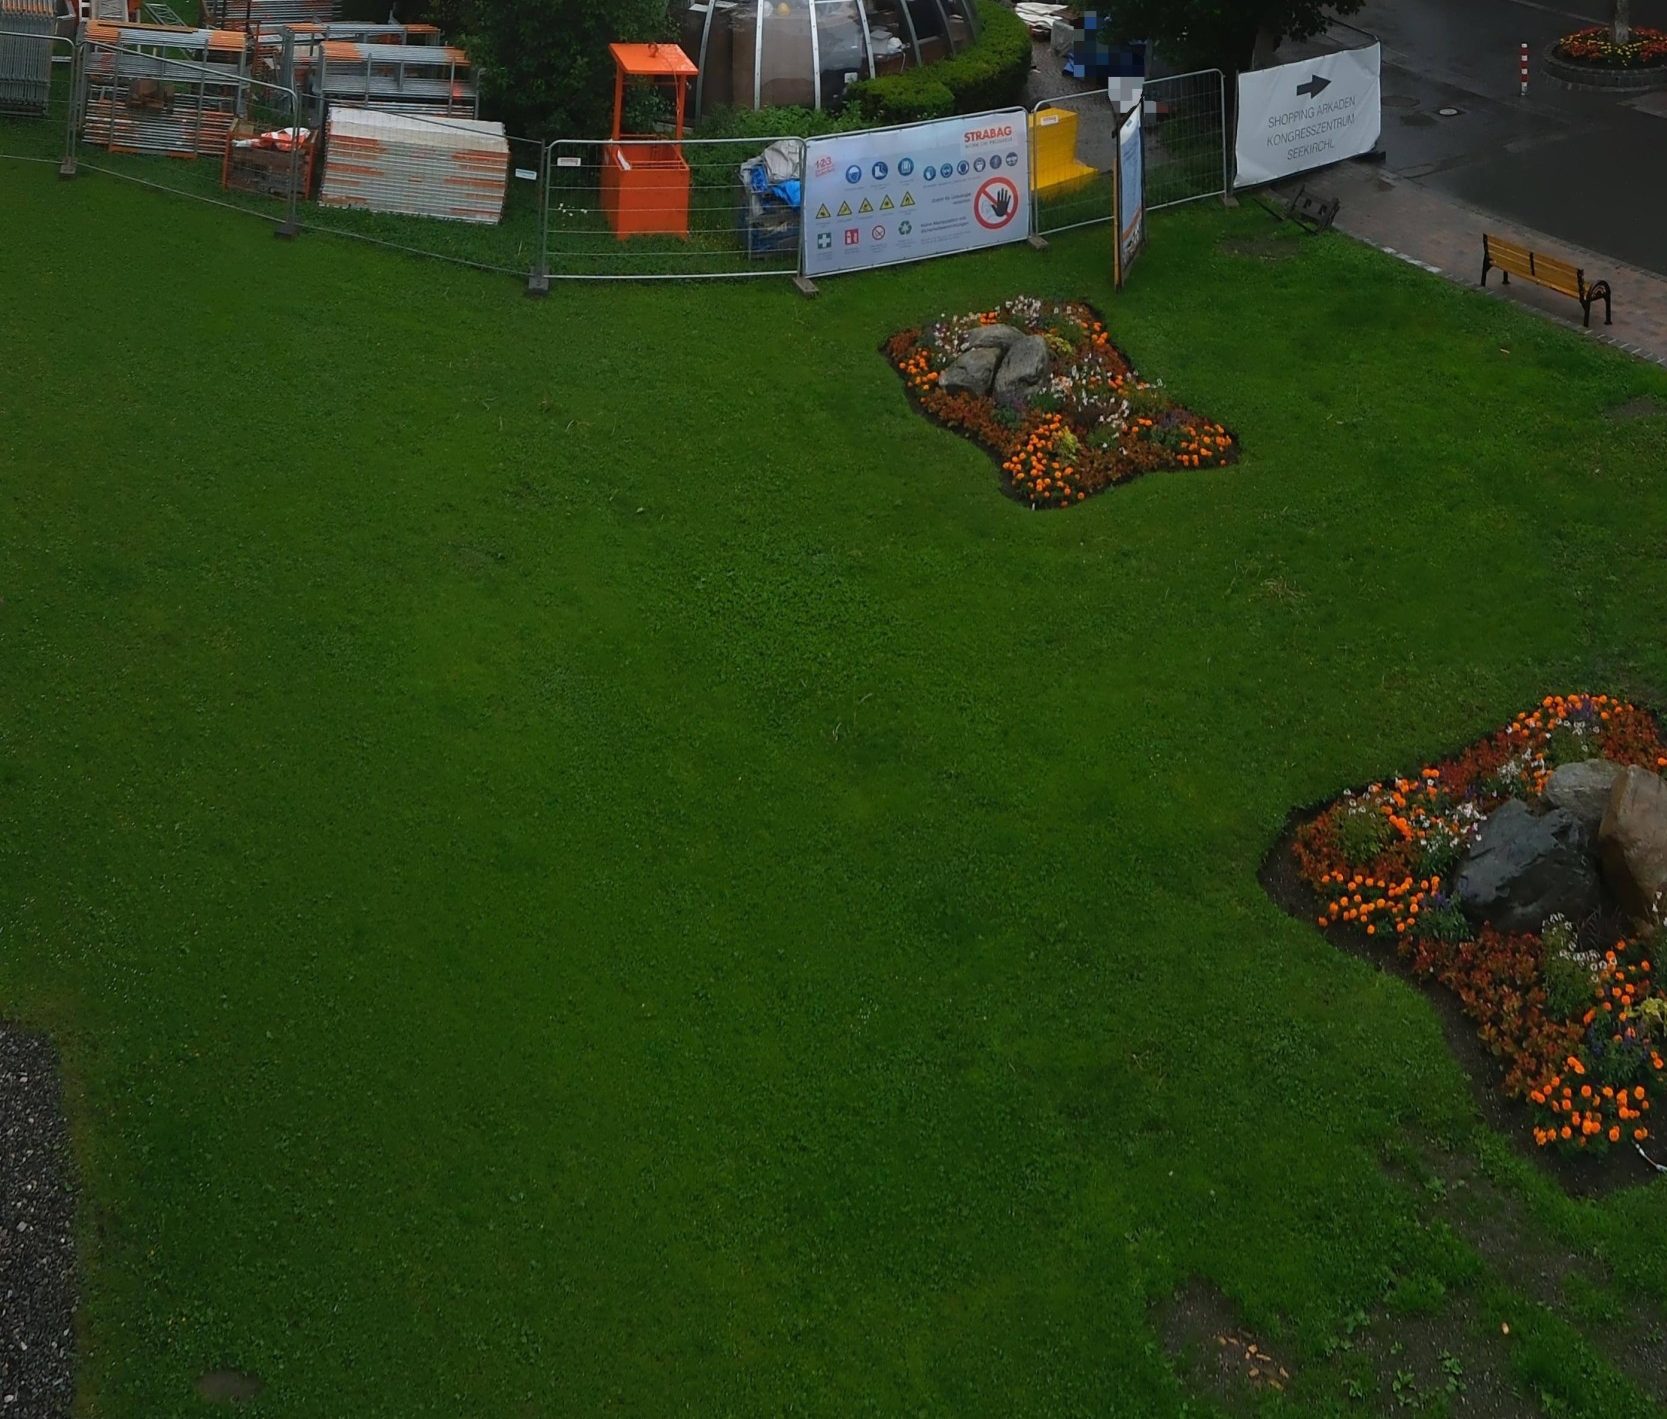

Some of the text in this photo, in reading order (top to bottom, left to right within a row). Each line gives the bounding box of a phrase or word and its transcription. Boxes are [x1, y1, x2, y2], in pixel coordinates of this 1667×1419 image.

[1268, 96, 1356, 129] SHOPPING ARKADEN
[964, 126, 1012, 143] STRABAG
[1266, 113, 1355, 147] KONGRESSZENTRUM
[1287, 138, 1335, 161] SEEKIRCHL
